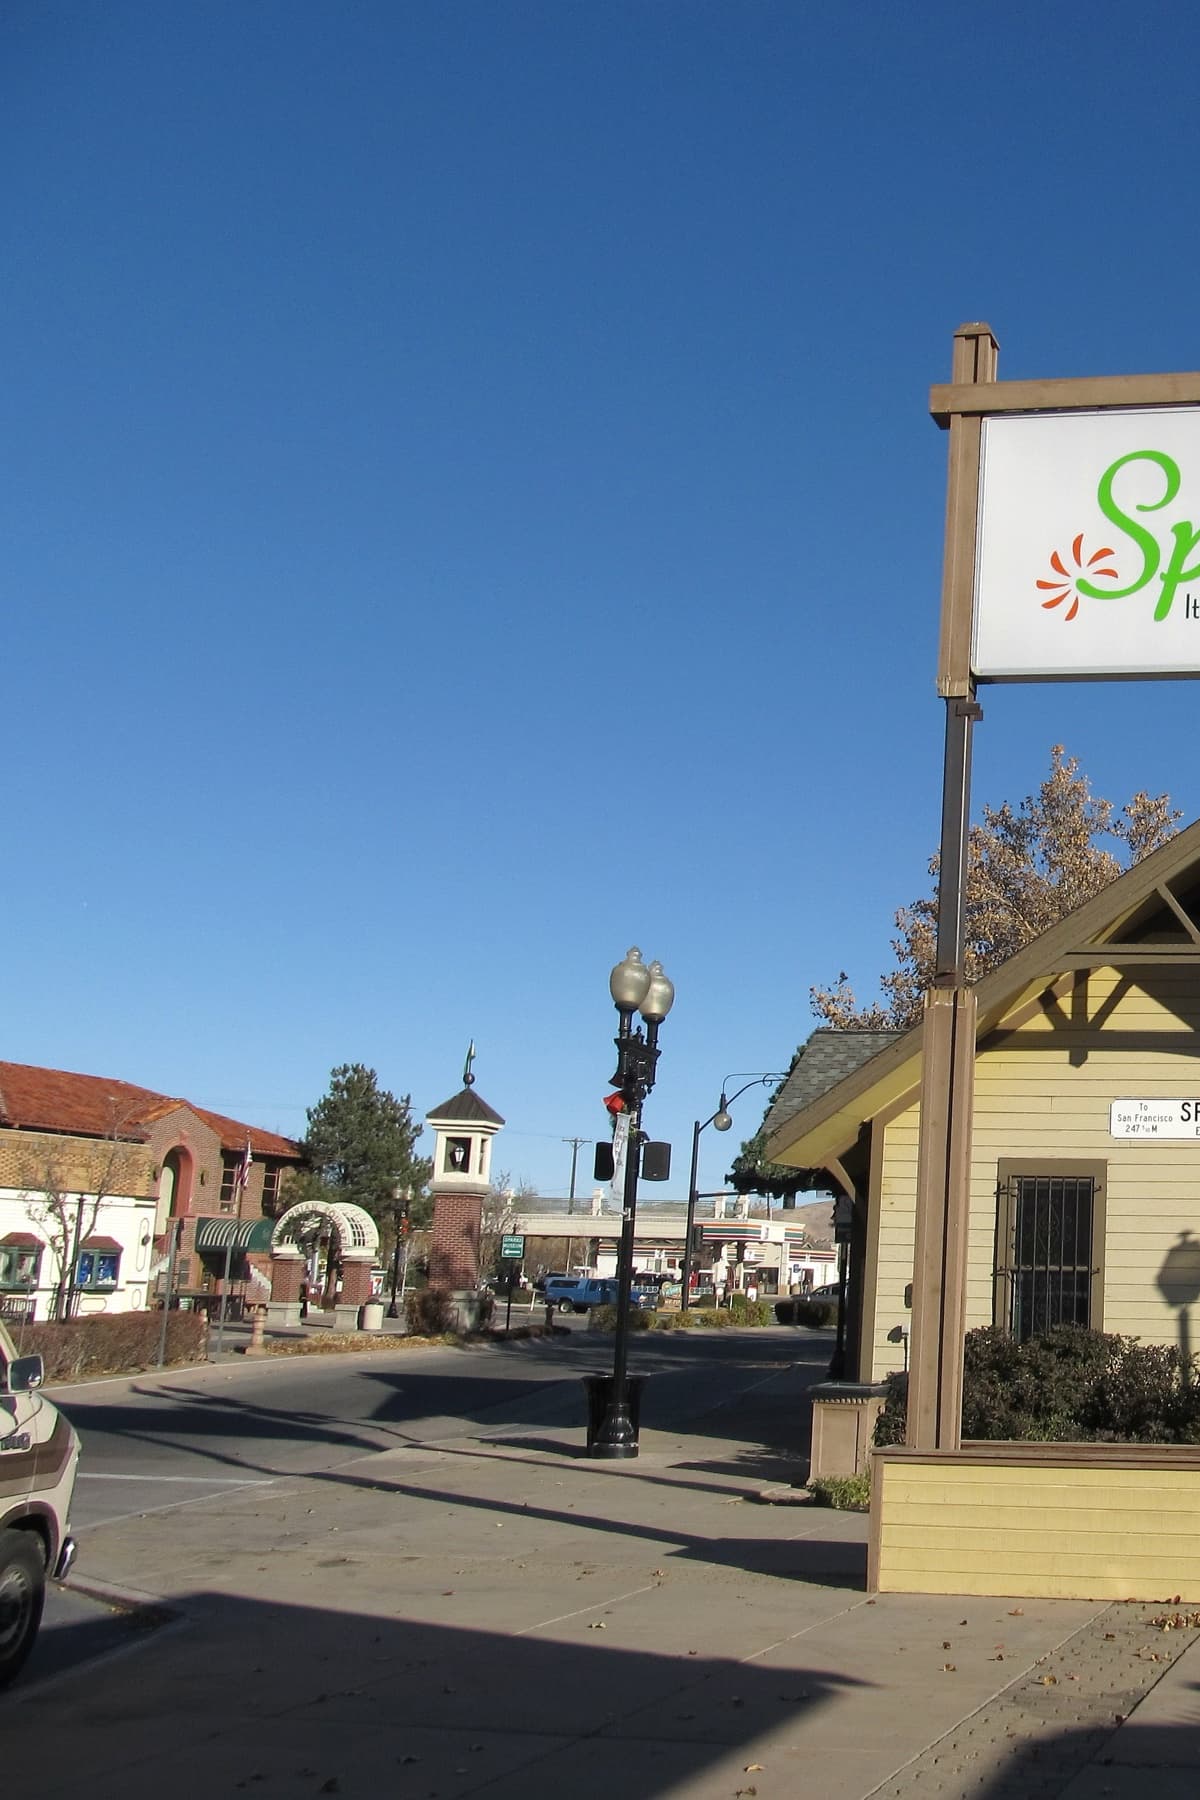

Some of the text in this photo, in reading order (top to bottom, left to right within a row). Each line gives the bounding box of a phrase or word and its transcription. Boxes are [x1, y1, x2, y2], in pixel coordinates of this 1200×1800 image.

[1139, 1103, 1149, 1112] To
[1117, 1113, 1173, 1123] San Francisco
